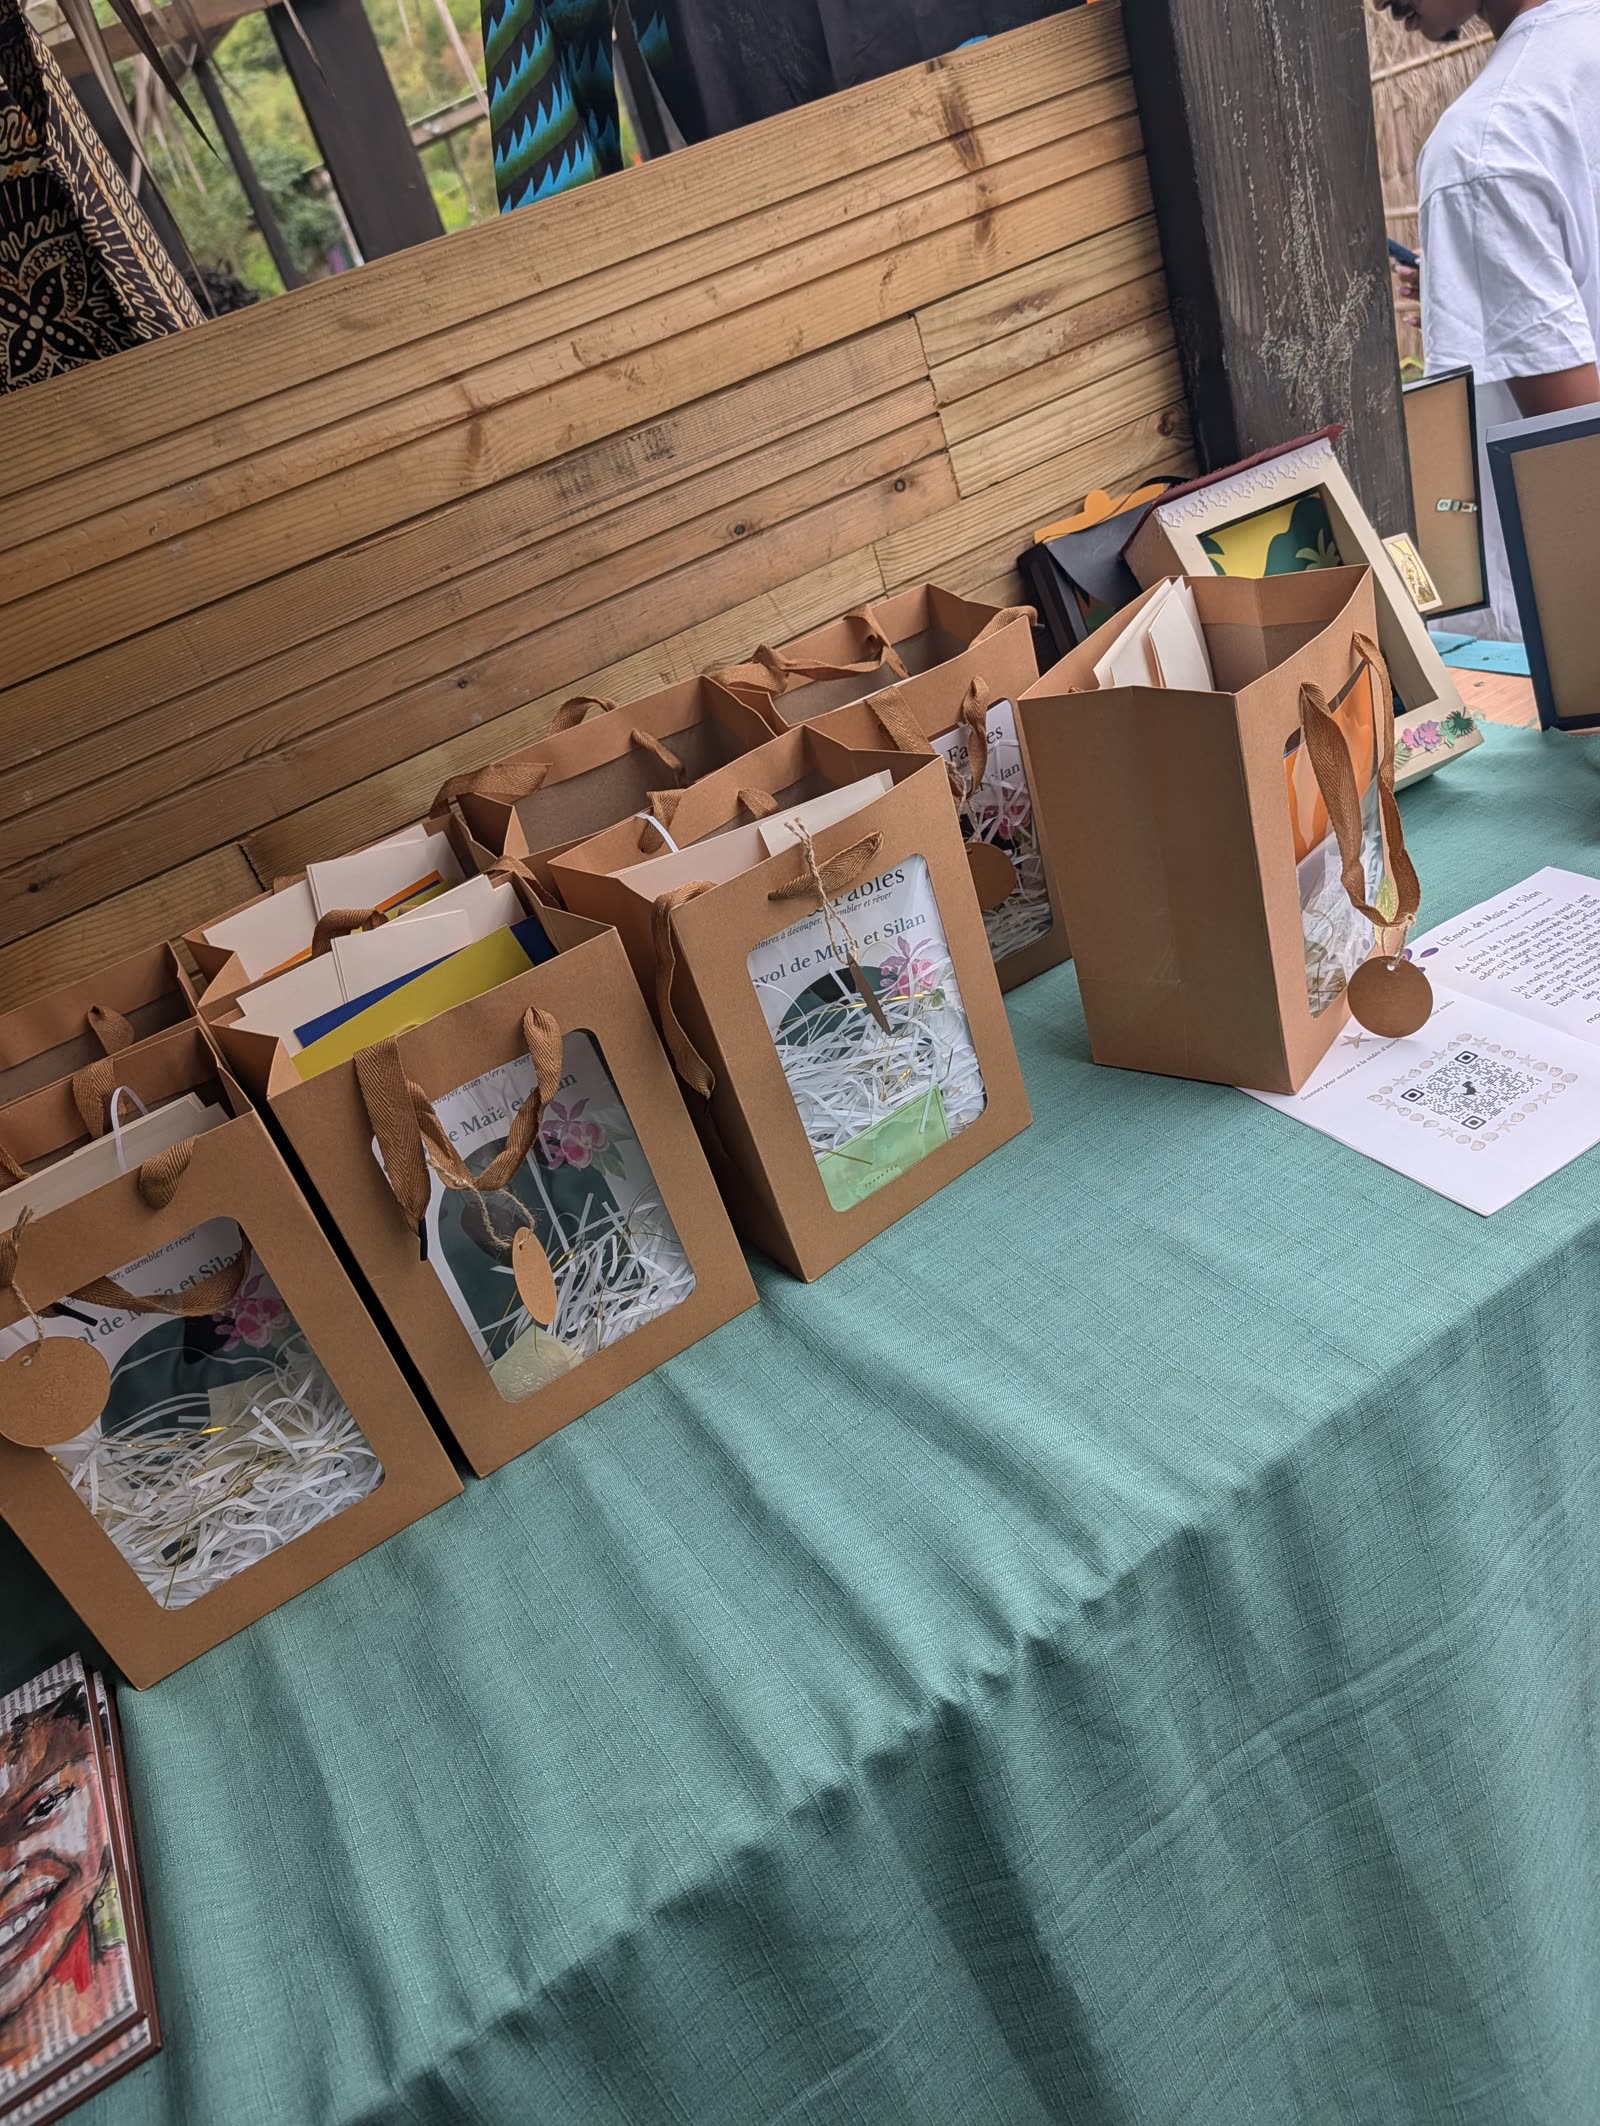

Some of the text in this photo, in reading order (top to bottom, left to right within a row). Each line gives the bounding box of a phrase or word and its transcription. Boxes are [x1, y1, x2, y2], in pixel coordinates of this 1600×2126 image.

[787, 918, 822, 937] découper,
[873, 892, 893, 905] rêver
[1436, 926, 1472, 946] L'Envol
[1470, 921, 1485, 929] de
[1508, 902, 1520, 910] et
[1516, 891, 1542, 902] Silan
[1455, 963, 1470, 972] Au
[1467, 949, 1490, 963] fond
[1487, 944, 1500, 952] de
[1496, 931, 1528, 946] l'océan
[1552, 903, 1575, 916] vivait
[1576, 894, 1590, 904] une
[791, 957, 811, 973] de
[863, 931, 881, 945] et
[883, 913, 927, 939] Silan
[1470, 957, 1495, 974] sirène
[1496, 939, 1531, 958] curieuse
[1531, 920, 1564, 939] nommée
[1581, 899, 1600, 908] Elle
[1479, 959, 1510, 980] adorait
[1510, 948, 1532, 960] nager
[1533, 937, 1553, 949] près
[1551, 930, 1564, 938] de
[1497, 971, 1511, 980] où
[1532, 942, 1563, 958] touche
[1559, 931, 1584, 943] l'eau
[1511, 985, 1527, 993] Un
[1552, 957, 1575, 971] alors
[1533, 948, 1573, 969] mouettes
[1522, 984, 1546, 999] d'une
[1547, 989, 1579, 1006] buvait
[1553, 980, 1570, 993] cerf
[125, 1248, 164, 1274] assembler
[166, 1243, 174, 1253] et
[99, 1314, 125, 1336] de
